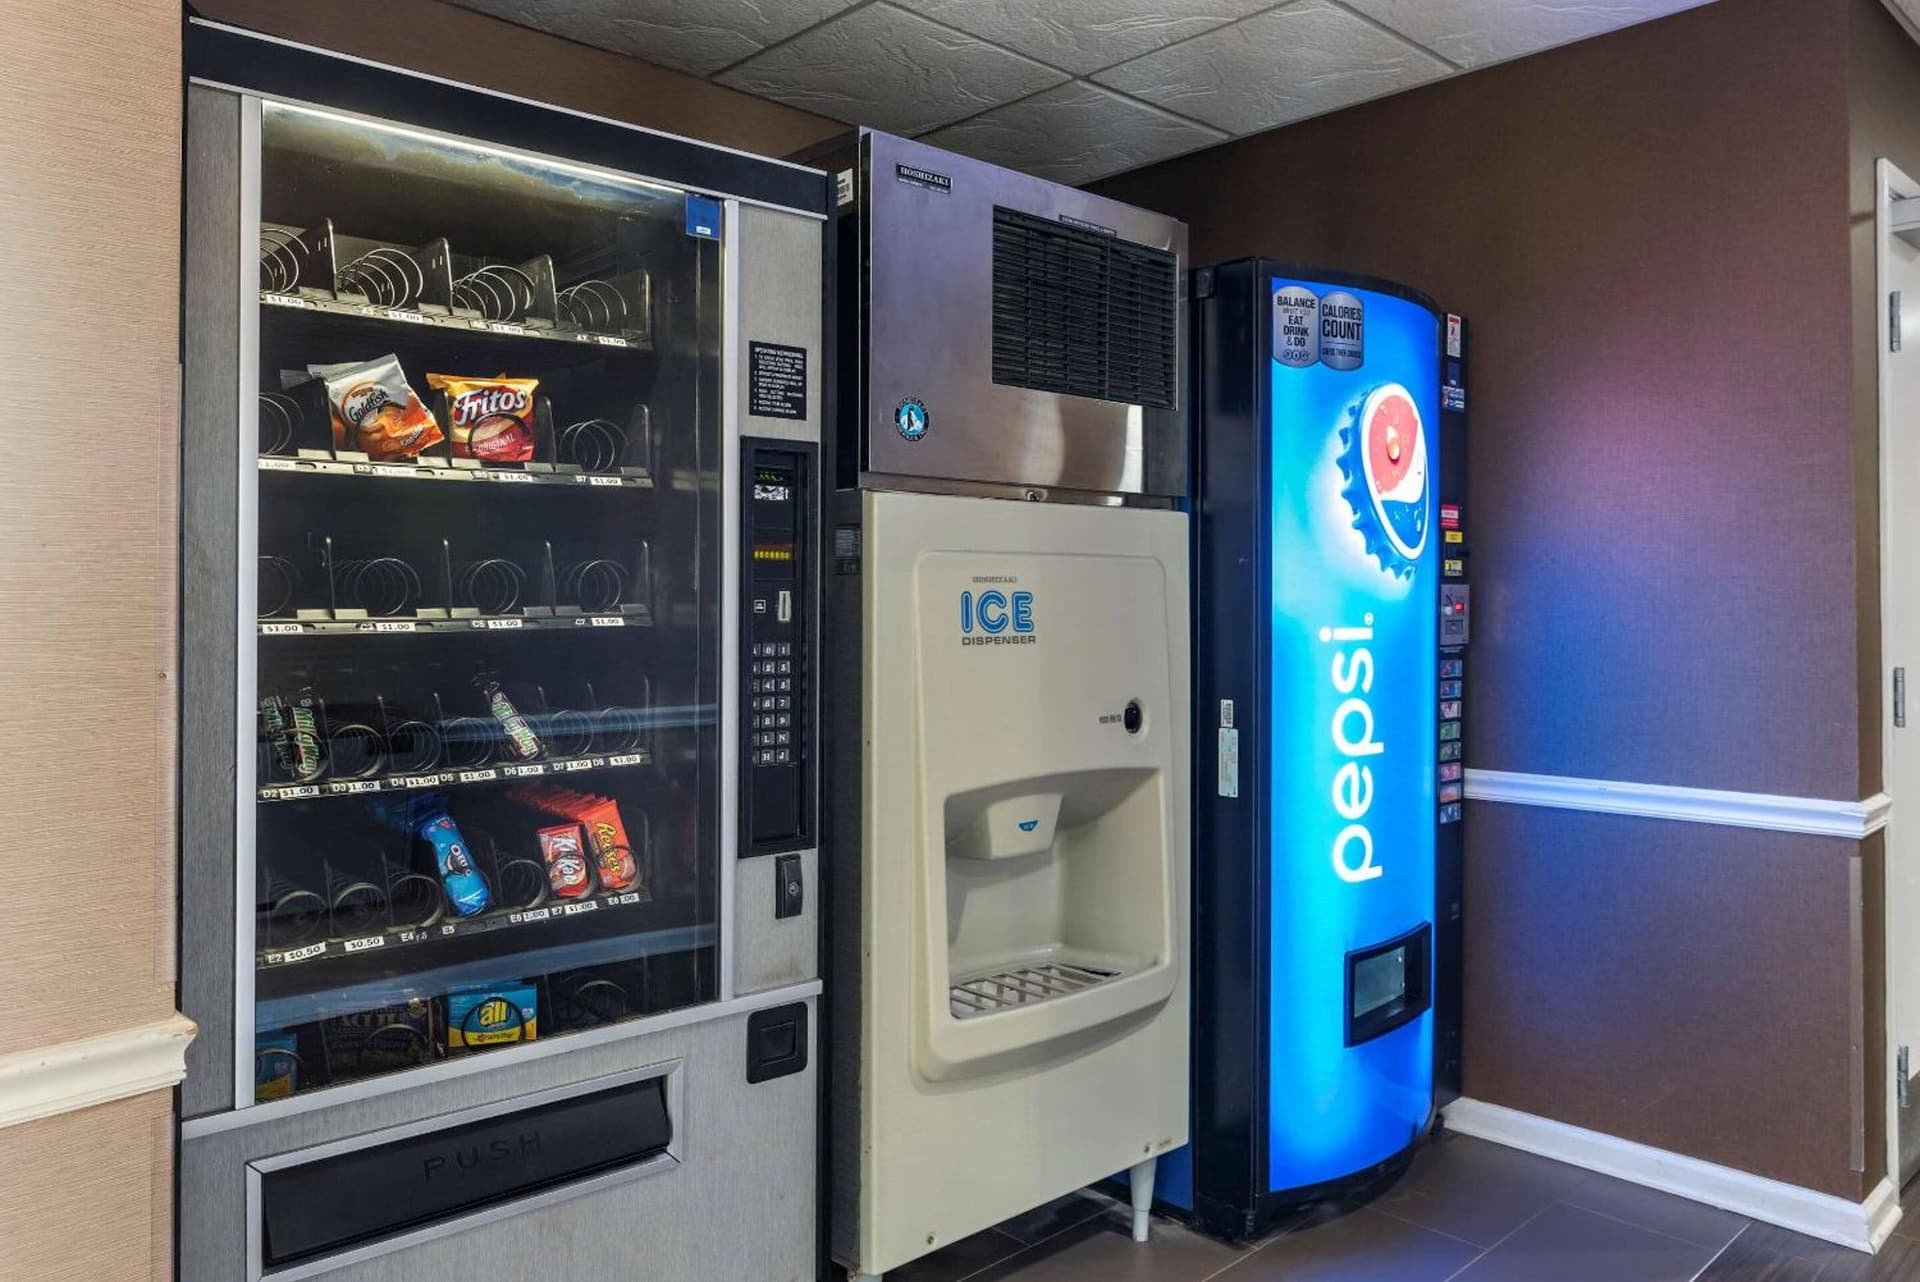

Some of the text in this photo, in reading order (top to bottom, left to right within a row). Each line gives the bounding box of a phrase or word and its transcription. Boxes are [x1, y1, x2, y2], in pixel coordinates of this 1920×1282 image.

[899, 167, 950, 187] HOSHIZAKI
[1276, 296, 1316, 309] BALANCE
[1322, 303, 1362, 321] CALORIES
[1283, 325, 1310, 337] DRINK
[1288, 315, 1304, 325] EAT
[1322, 319, 1362, 341] COUNT
[349, 387, 390, 424] Goldfish
[453, 387, 528, 426] Fritos
[961, 590, 1034, 634] ICE
[962, 635, 1037, 646] DISPENSER
[1319, 626, 1384, 883] pepsi
[479, 999, 508, 1027] all
[423, 1131, 541, 1181] PUSH
